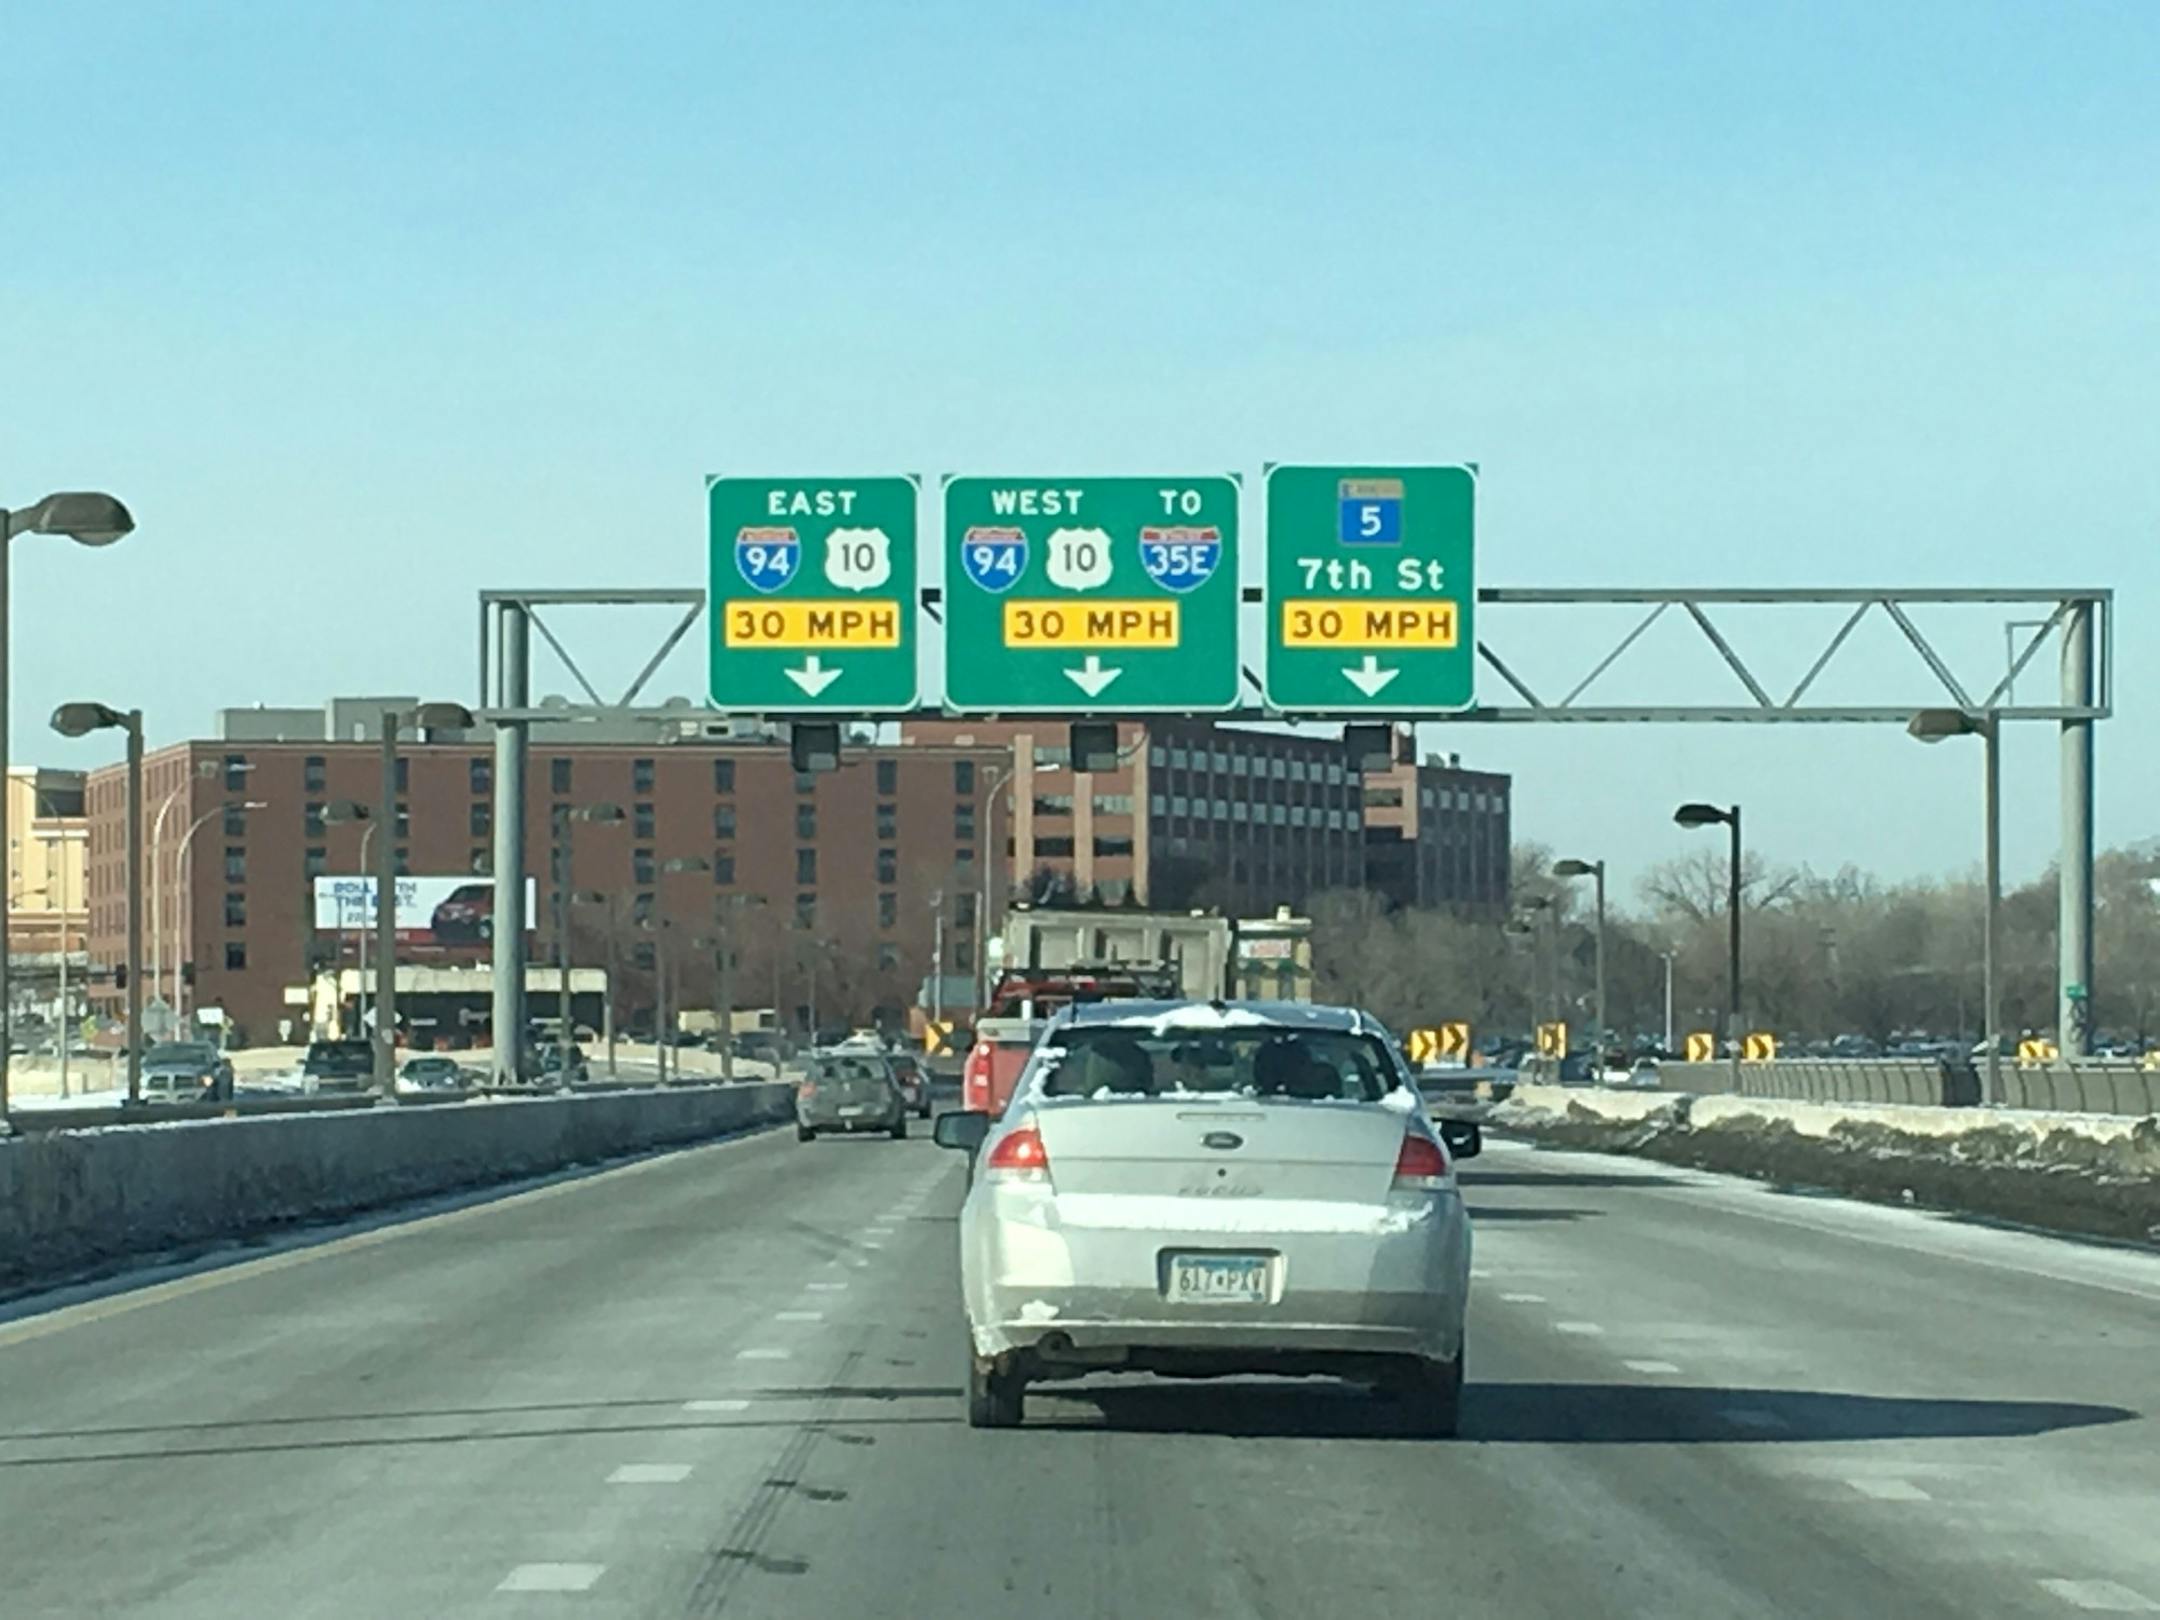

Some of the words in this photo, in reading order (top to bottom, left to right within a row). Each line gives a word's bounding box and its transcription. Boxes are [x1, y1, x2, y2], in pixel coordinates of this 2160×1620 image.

[768, 490, 857, 516] EAST
[991, 489, 1083, 515] WEST
[1159, 489, 1202, 516] TO
[1360, 505, 1382, 537] 5
[745, 546, 790, 577] 94
[841, 543, 876, 572] 10
[972, 546, 1018, 576] 94
[1063, 543, 1097, 572] 10
[1149, 546, 1211, 577] 35E
[1296, 557, 1372, 591] 7th
[1397, 557, 1444, 591] St
[734, 610, 786, 640] 30
[807, 610, 894, 640] MPH
[1013, 610, 1065, 640] 30
[1086, 610, 1173, 640] MPH
[1291, 609, 1343, 640] 30
[1365, 609, 1452, 640] MPH
